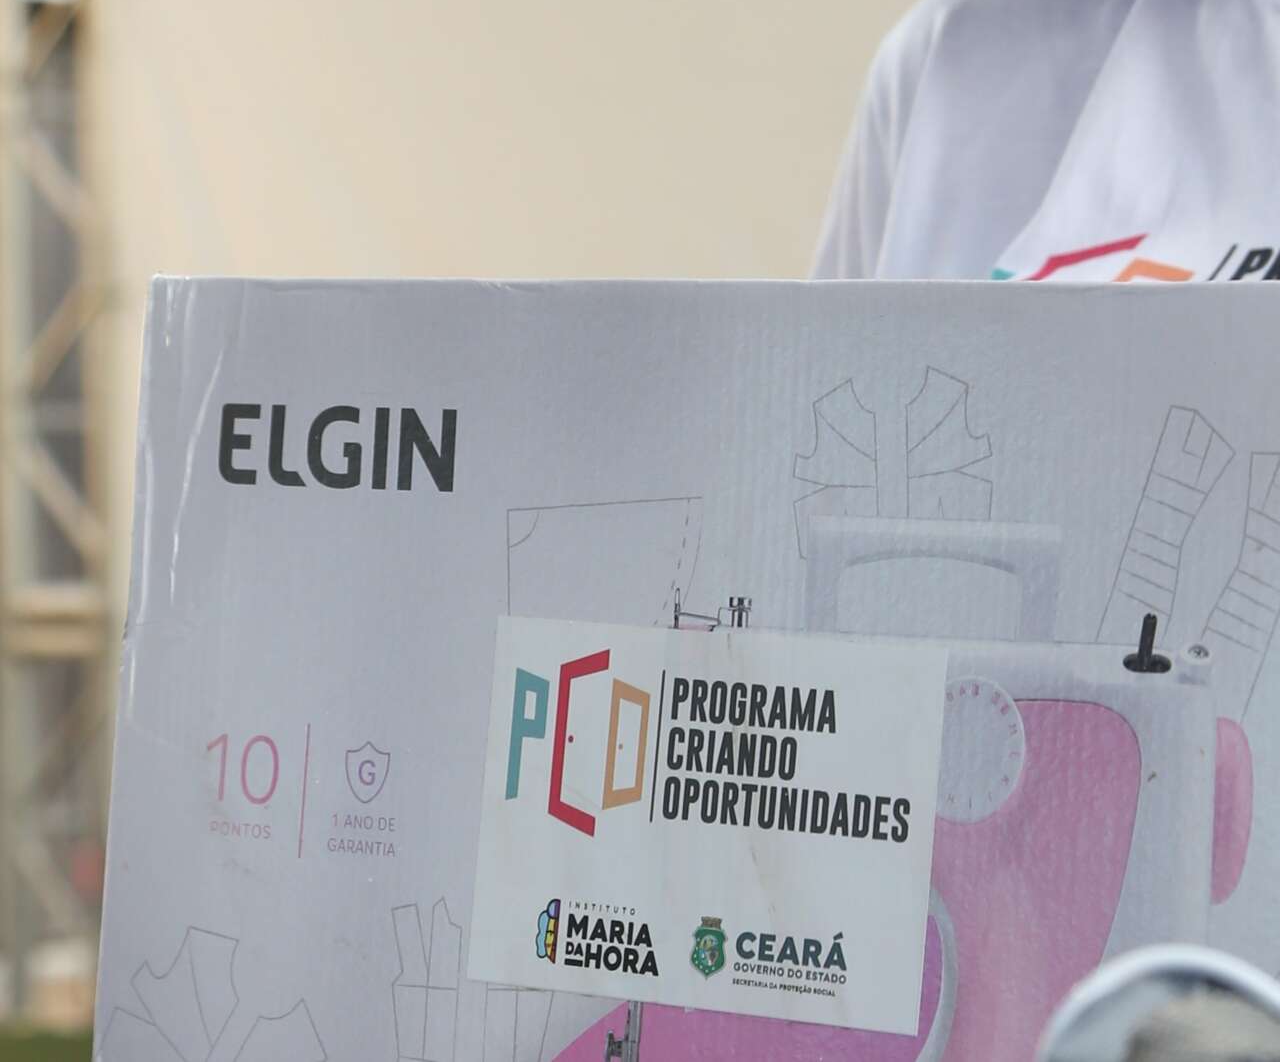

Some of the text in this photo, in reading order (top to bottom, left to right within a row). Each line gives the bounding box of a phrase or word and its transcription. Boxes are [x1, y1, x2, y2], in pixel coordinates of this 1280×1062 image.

[217, 403, 458, 493] ELGIN
[671, 677, 836, 734] PROGRAMA
[207, 734, 279, 805] 10
[667, 726, 798, 781] CRIANDO
[344, 815, 374, 831] ANO
[378, 817, 396, 832] DE
[662, 776, 911, 844] OPORTUNIDADES
[209, 820, 272, 839] PONTOS
[327, 837, 396, 857] GARANTIA
[568, 900, 636, 916] INSTITUTO
[566, 913, 653, 948] MARIA
[565, 941, 659, 977] DA HORA
[735, 931, 847, 971] CEARÁ
[732, 978, 768, 989] SECRETARIA
[779, 983, 812, 994] PROTEÇÃO
[813, 987, 836, 997] SOCIAL
[733, 962, 847, 985] GOVERNO DO ESTADO
